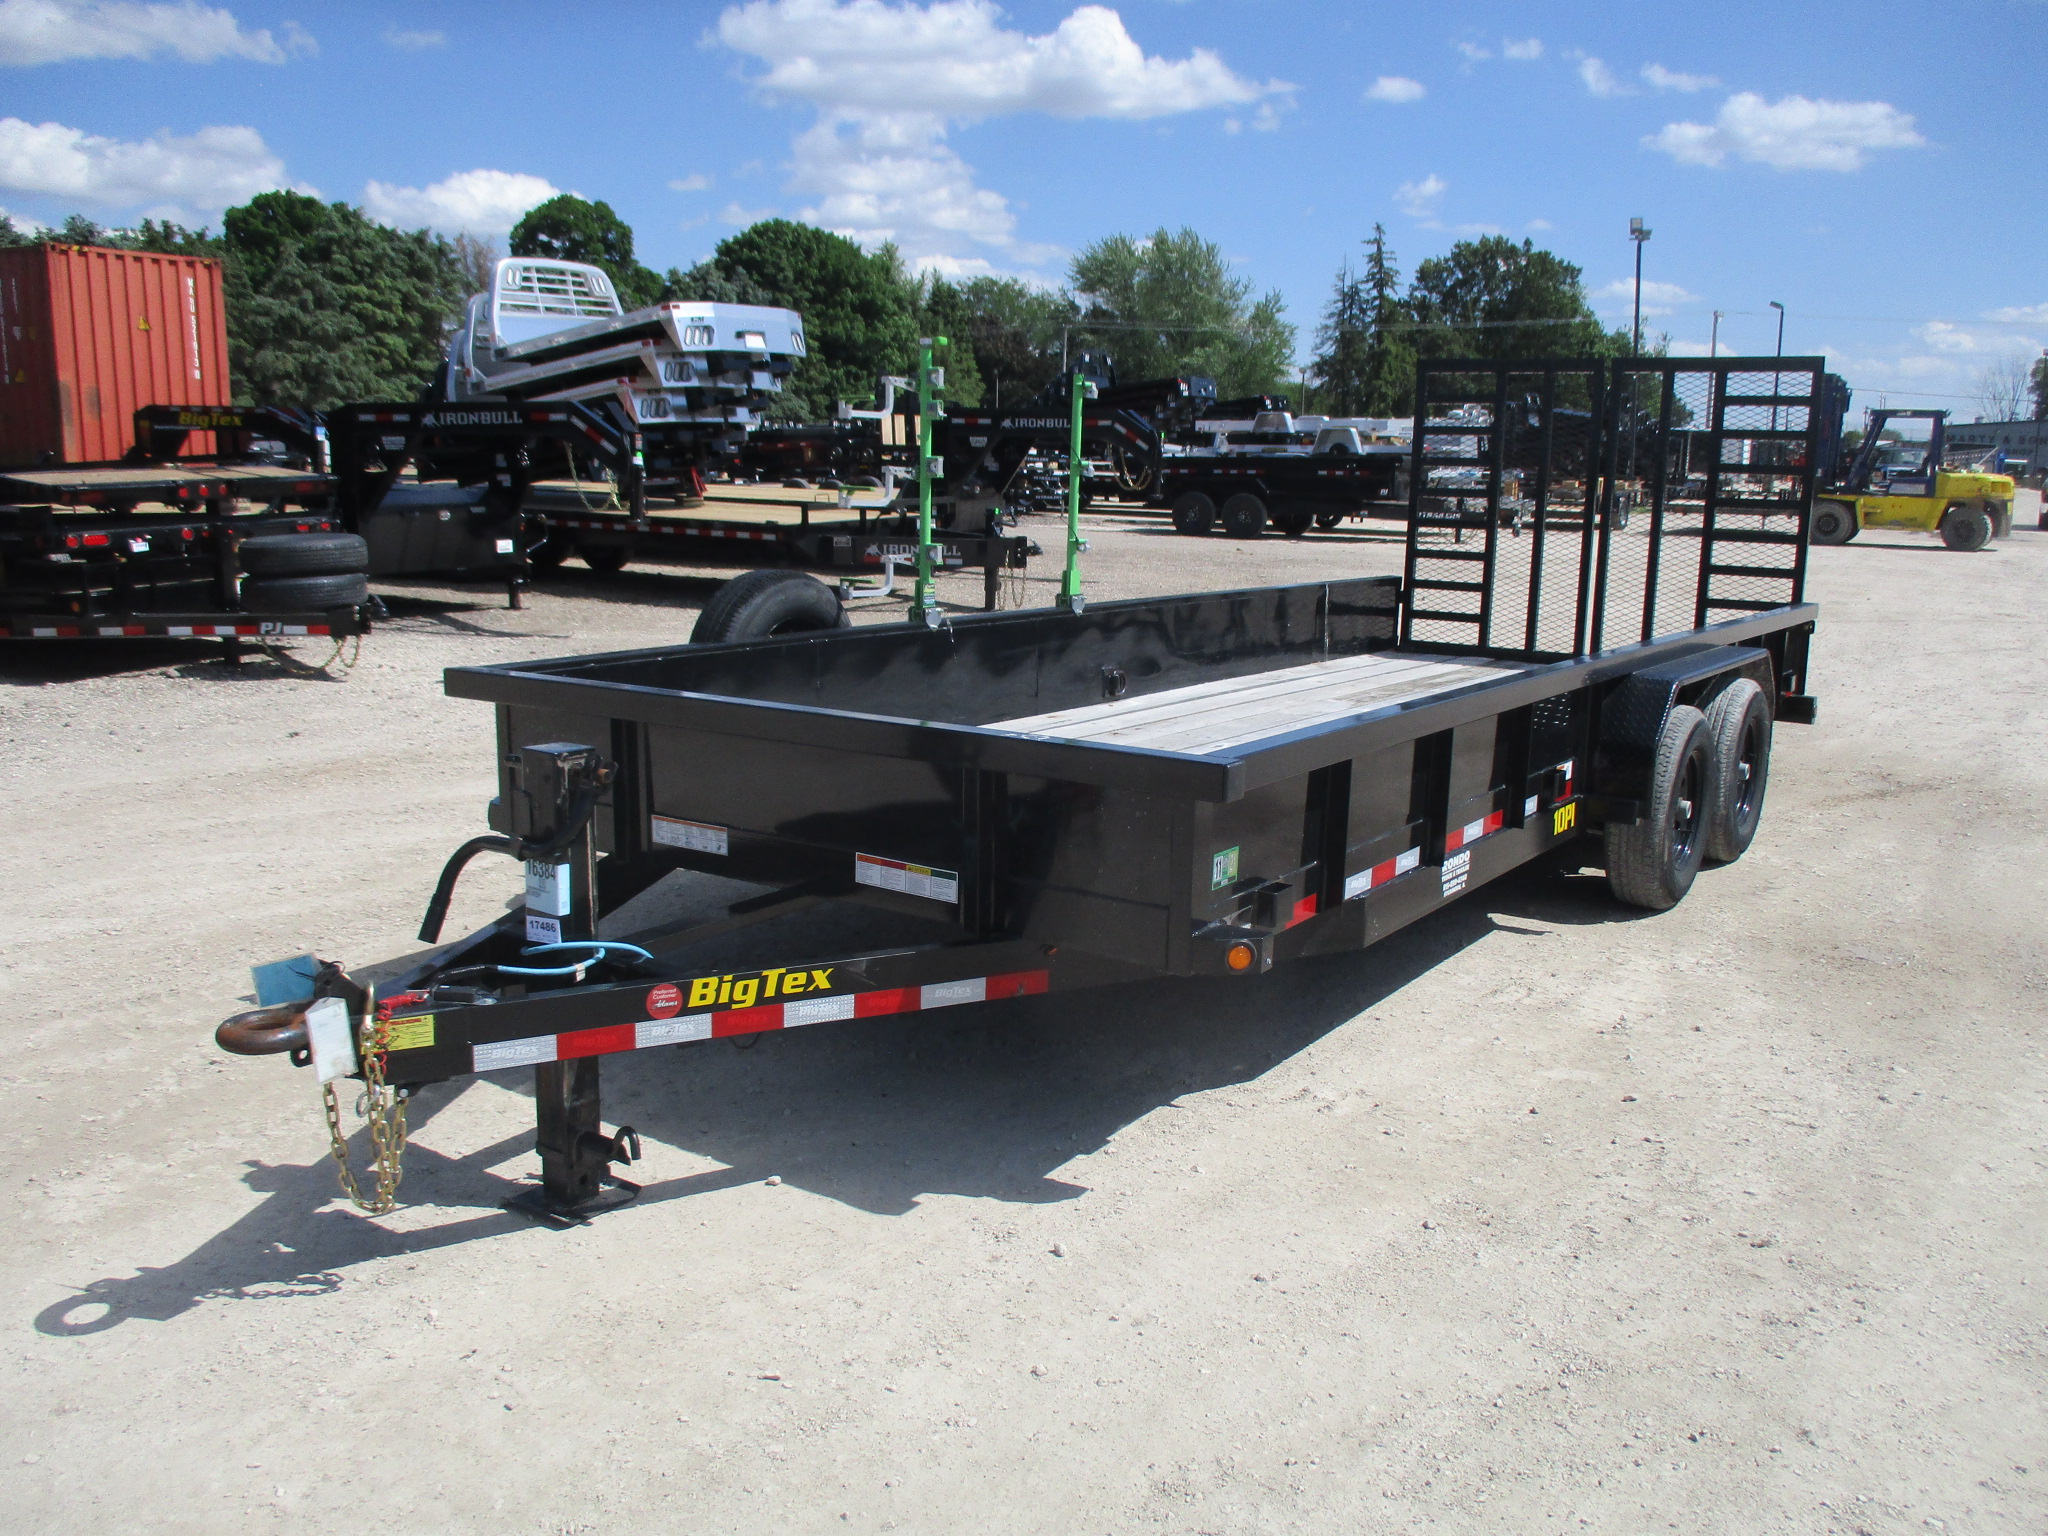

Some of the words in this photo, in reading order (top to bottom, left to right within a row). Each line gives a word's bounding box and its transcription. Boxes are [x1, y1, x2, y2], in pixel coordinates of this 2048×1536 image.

[178, 412, 243, 428] BigTex
[440, 411, 523, 425] IRONBULL
[1015, 418, 1071, 429] IRONBUL
[883, 544, 962, 557] IRONLL
[260, 622, 283, 635] PJ
[529, 920, 556, 933] 17486
[687, 968, 835, 1010] BigTex
